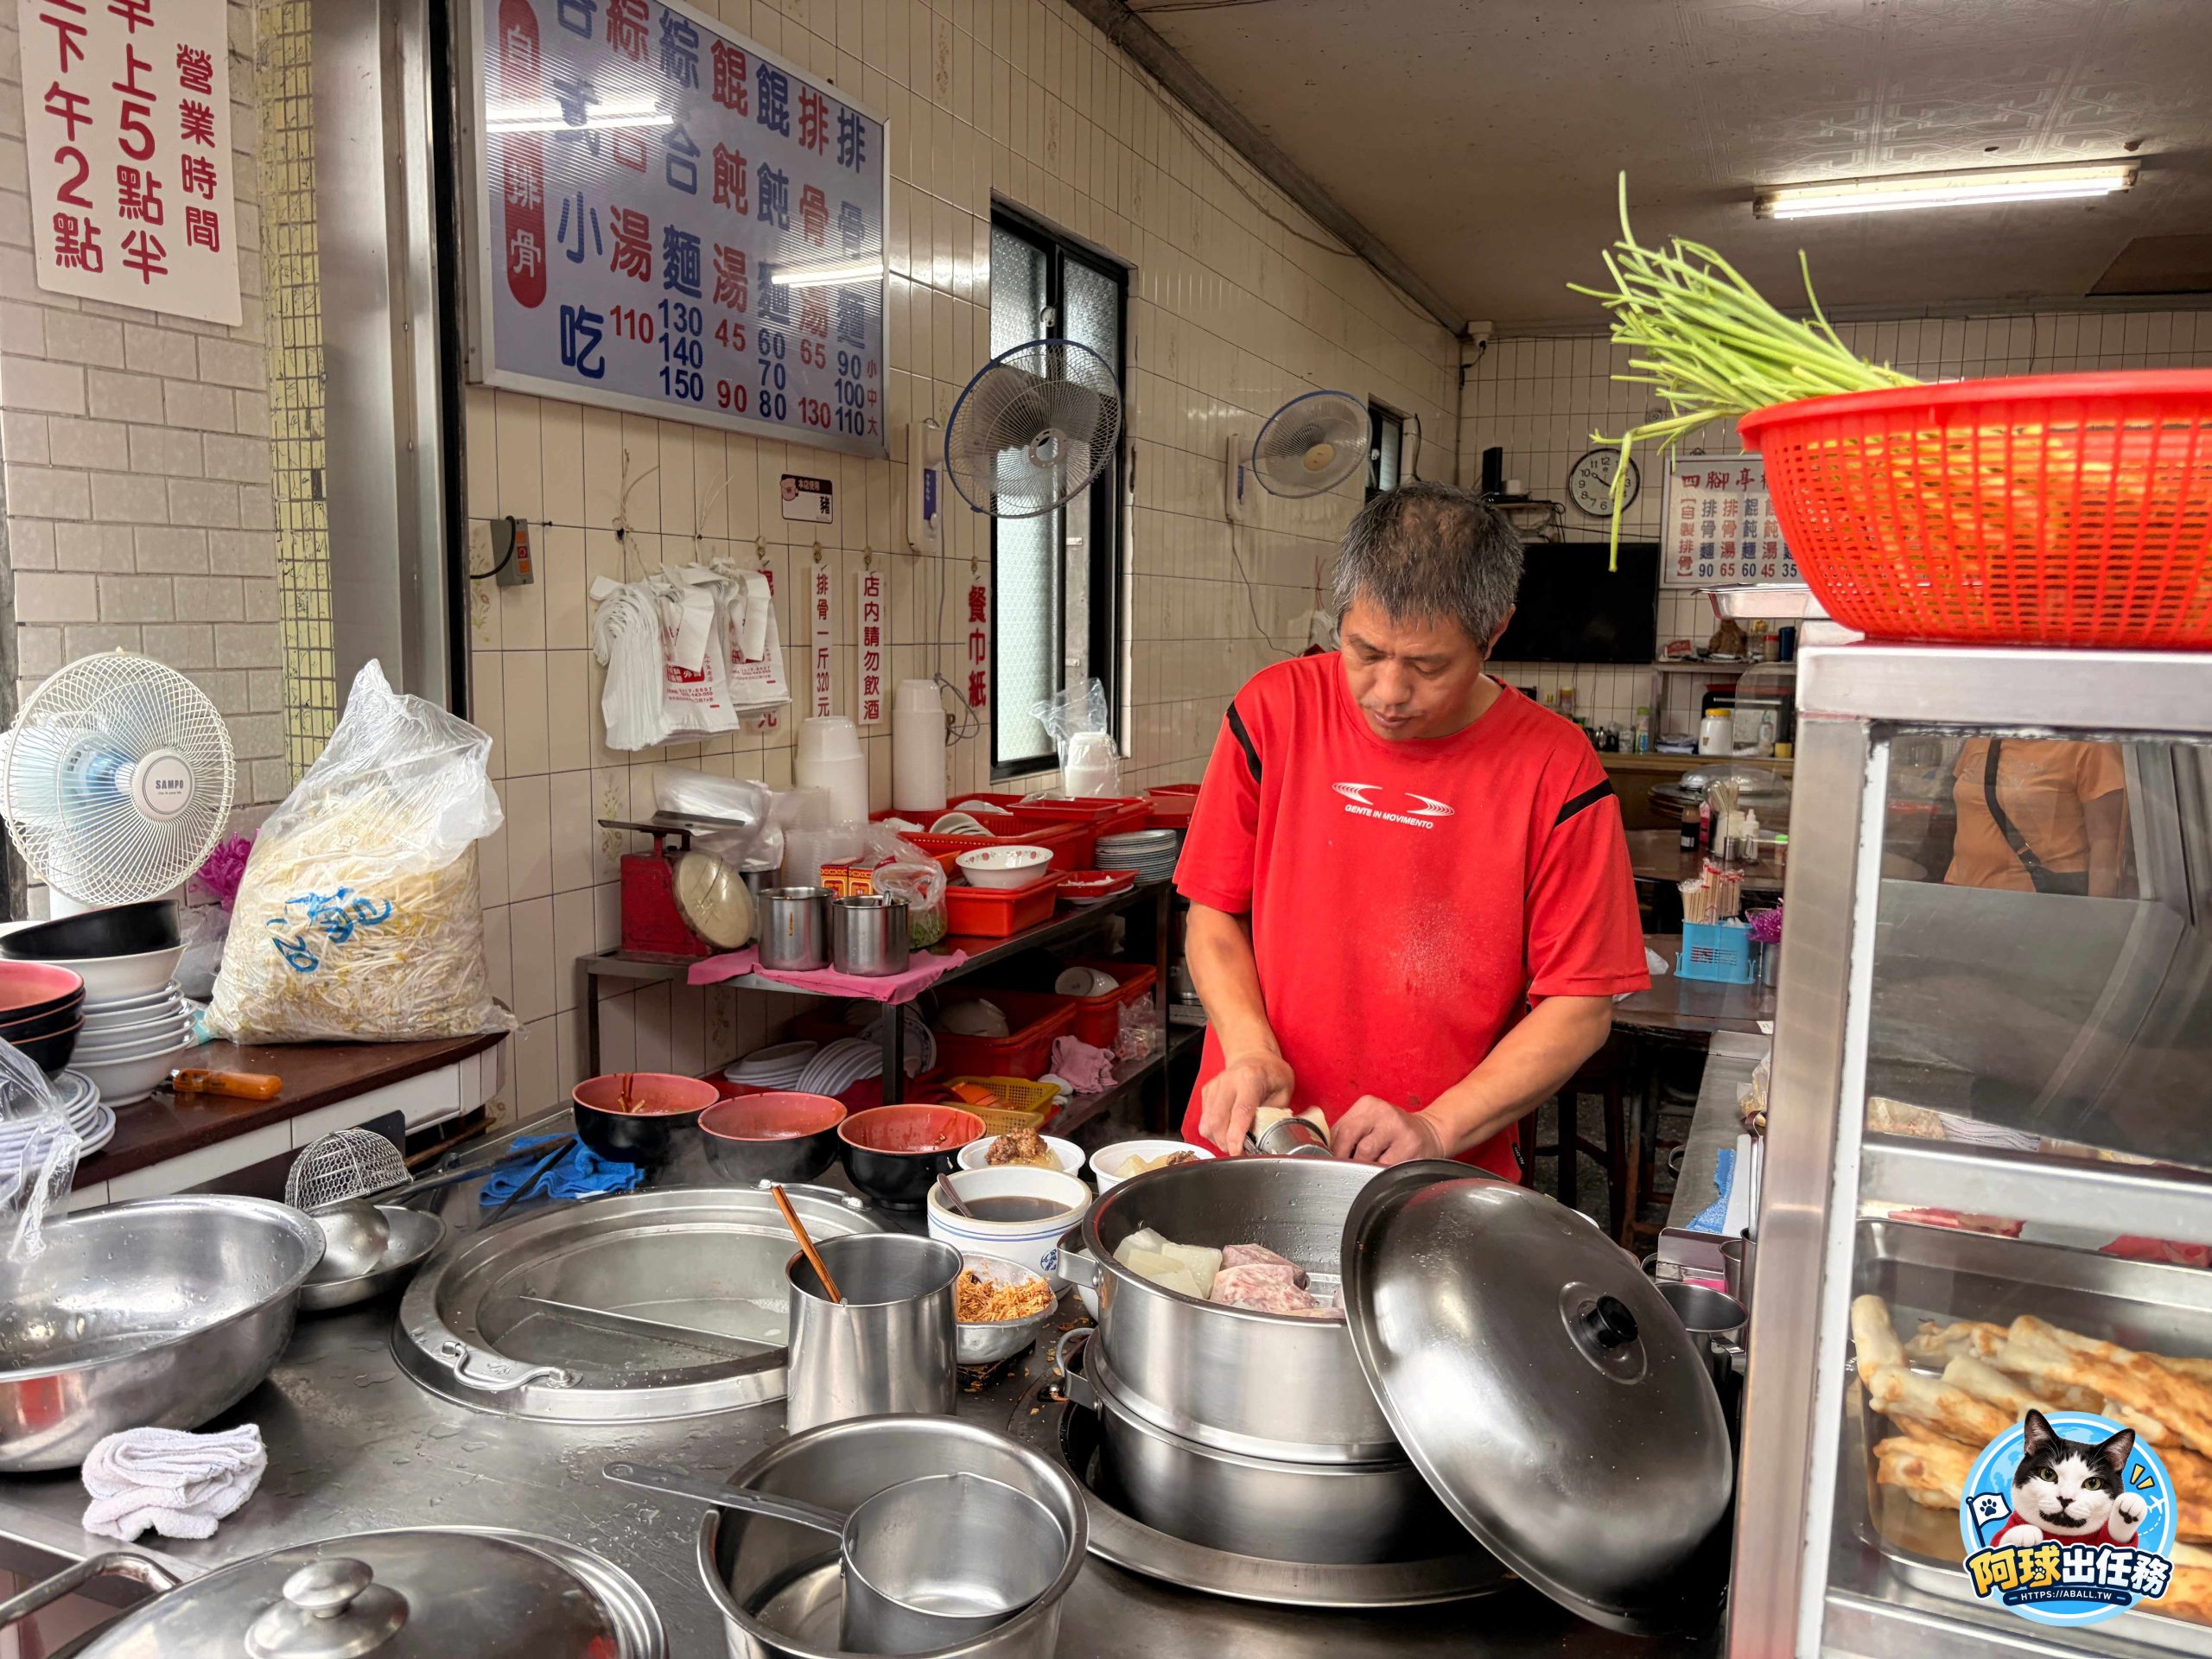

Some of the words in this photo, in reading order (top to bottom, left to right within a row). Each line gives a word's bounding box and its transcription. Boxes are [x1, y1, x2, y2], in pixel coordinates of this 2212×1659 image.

[107, 0, 168, 284] 早上5點半
[176, 43, 219, 252] 營業時間
[505, 23, 543, 278] 自排骨
[658, 10, 702, 299] 綜合麵
[710, 39, 748, 313] 餛飩湯
[756, 63, 791, 326] 餛飩麵
[798, 86, 830, 338] 排骨湯
[837, 107, 866, 349] 排骨麵
[610, 305, 653, 344] 110
[658, 298, 702, 337] 130
[659, 333, 702, 369] 140
[715, 319, 746, 352] 45
[758, 328, 785, 359] 60
[800, 339, 826, 370] 65
[837, 351, 861, 380] 90
[867, 359, 877, 378] 小
[659, 366, 703, 402] 150
[758, 359, 785, 391] 70
[717, 380, 747, 413] 90
[759, 390, 786, 421] 80
[835, 378, 864, 409] 100
[868, 389, 877, 408] 中
[798, 397, 831, 429] 130
[836, 407, 864, 436] 110
[868, 419, 878, 436] 大
[1580, 468, 1591, 477] 10
[1591, 460, 1598, 468] 11
[1601, 457, 1610, 466] 12
[1579, 480, 1586, 488] 9
[1581, 491, 1588, 499] 8
[1681, 467, 1770, 493] 四腳亭
[820, 496, 830, 515] 豬
[1590, 498, 1597, 506] 7
[1600, 501, 1607, 510] 6
[1699, 499, 1718, 560] 排骨麵
[1720, 499, 1738, 559] 排骨湯
[1741, 499, 1758, 560] 餛飩麵
[1699, 563, 1714, 577] 90
[1719, 563, 1735, 576] 65
[1741, 563, 1757, 577] 60
[1761, 563, 1775, 577] 45
[1782, 563, 1797, 577] 35
[817, 574, 830, 717] 排骨一斤320元
[864, 576, 880, 721] 店內請勿飲酒
[969, 585, 987, 708] 餐巾紙
[156, 779, 184, 789] SAMPO
[1344, 804, 1372, 817] GENTE
[1372, 810, 1382, 818] IN
[1382, 812, 1433, 830] MOVIMENTO
